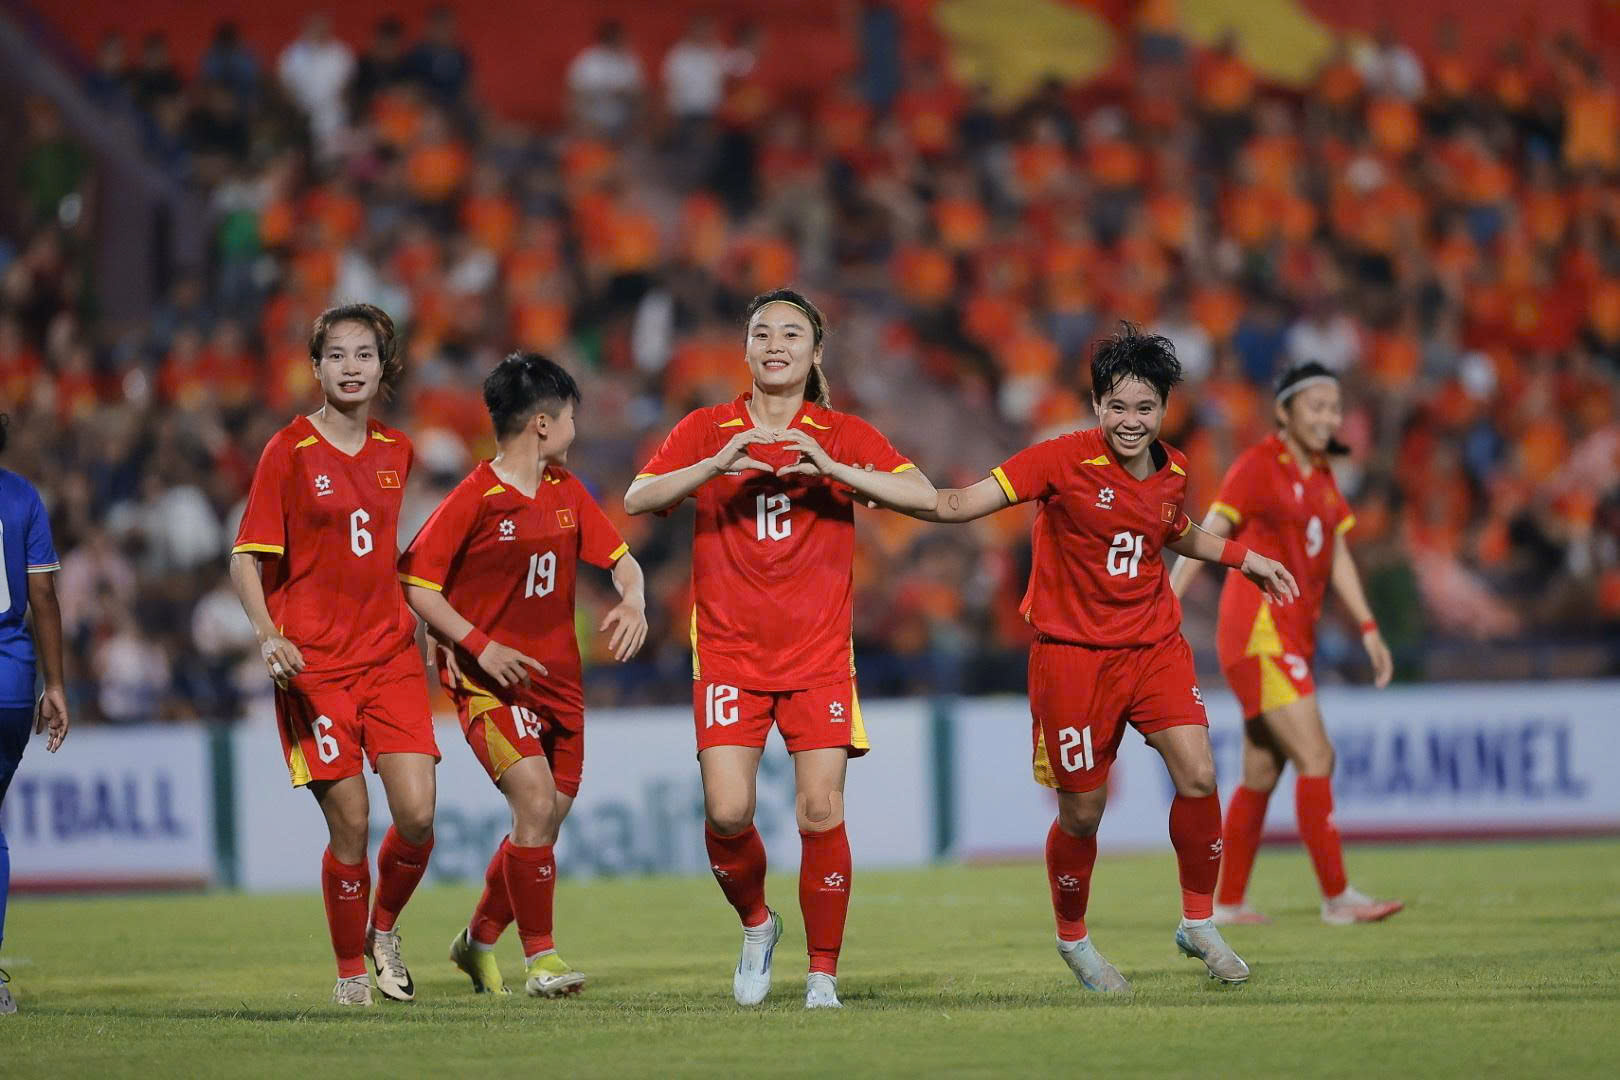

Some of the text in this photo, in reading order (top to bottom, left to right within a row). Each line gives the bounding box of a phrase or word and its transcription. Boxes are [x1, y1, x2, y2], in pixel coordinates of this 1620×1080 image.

[350, 508, 373, 557] 6
[756, 493, 792, 542] 12
[1306, 515, 1323, 558] 9
[525, 551, 556, 599] 19
[1106, 531, 1144, 579] 21
[510, 705, 541, 739] 19
[705, 682, 739, 729] 12
[311, 715, 340, 764] 6
[1058, 725, 1094, 773] 21
[1330, 717, 1592, 800] HANNEL
[0, 771, 187, 840] TBALL
